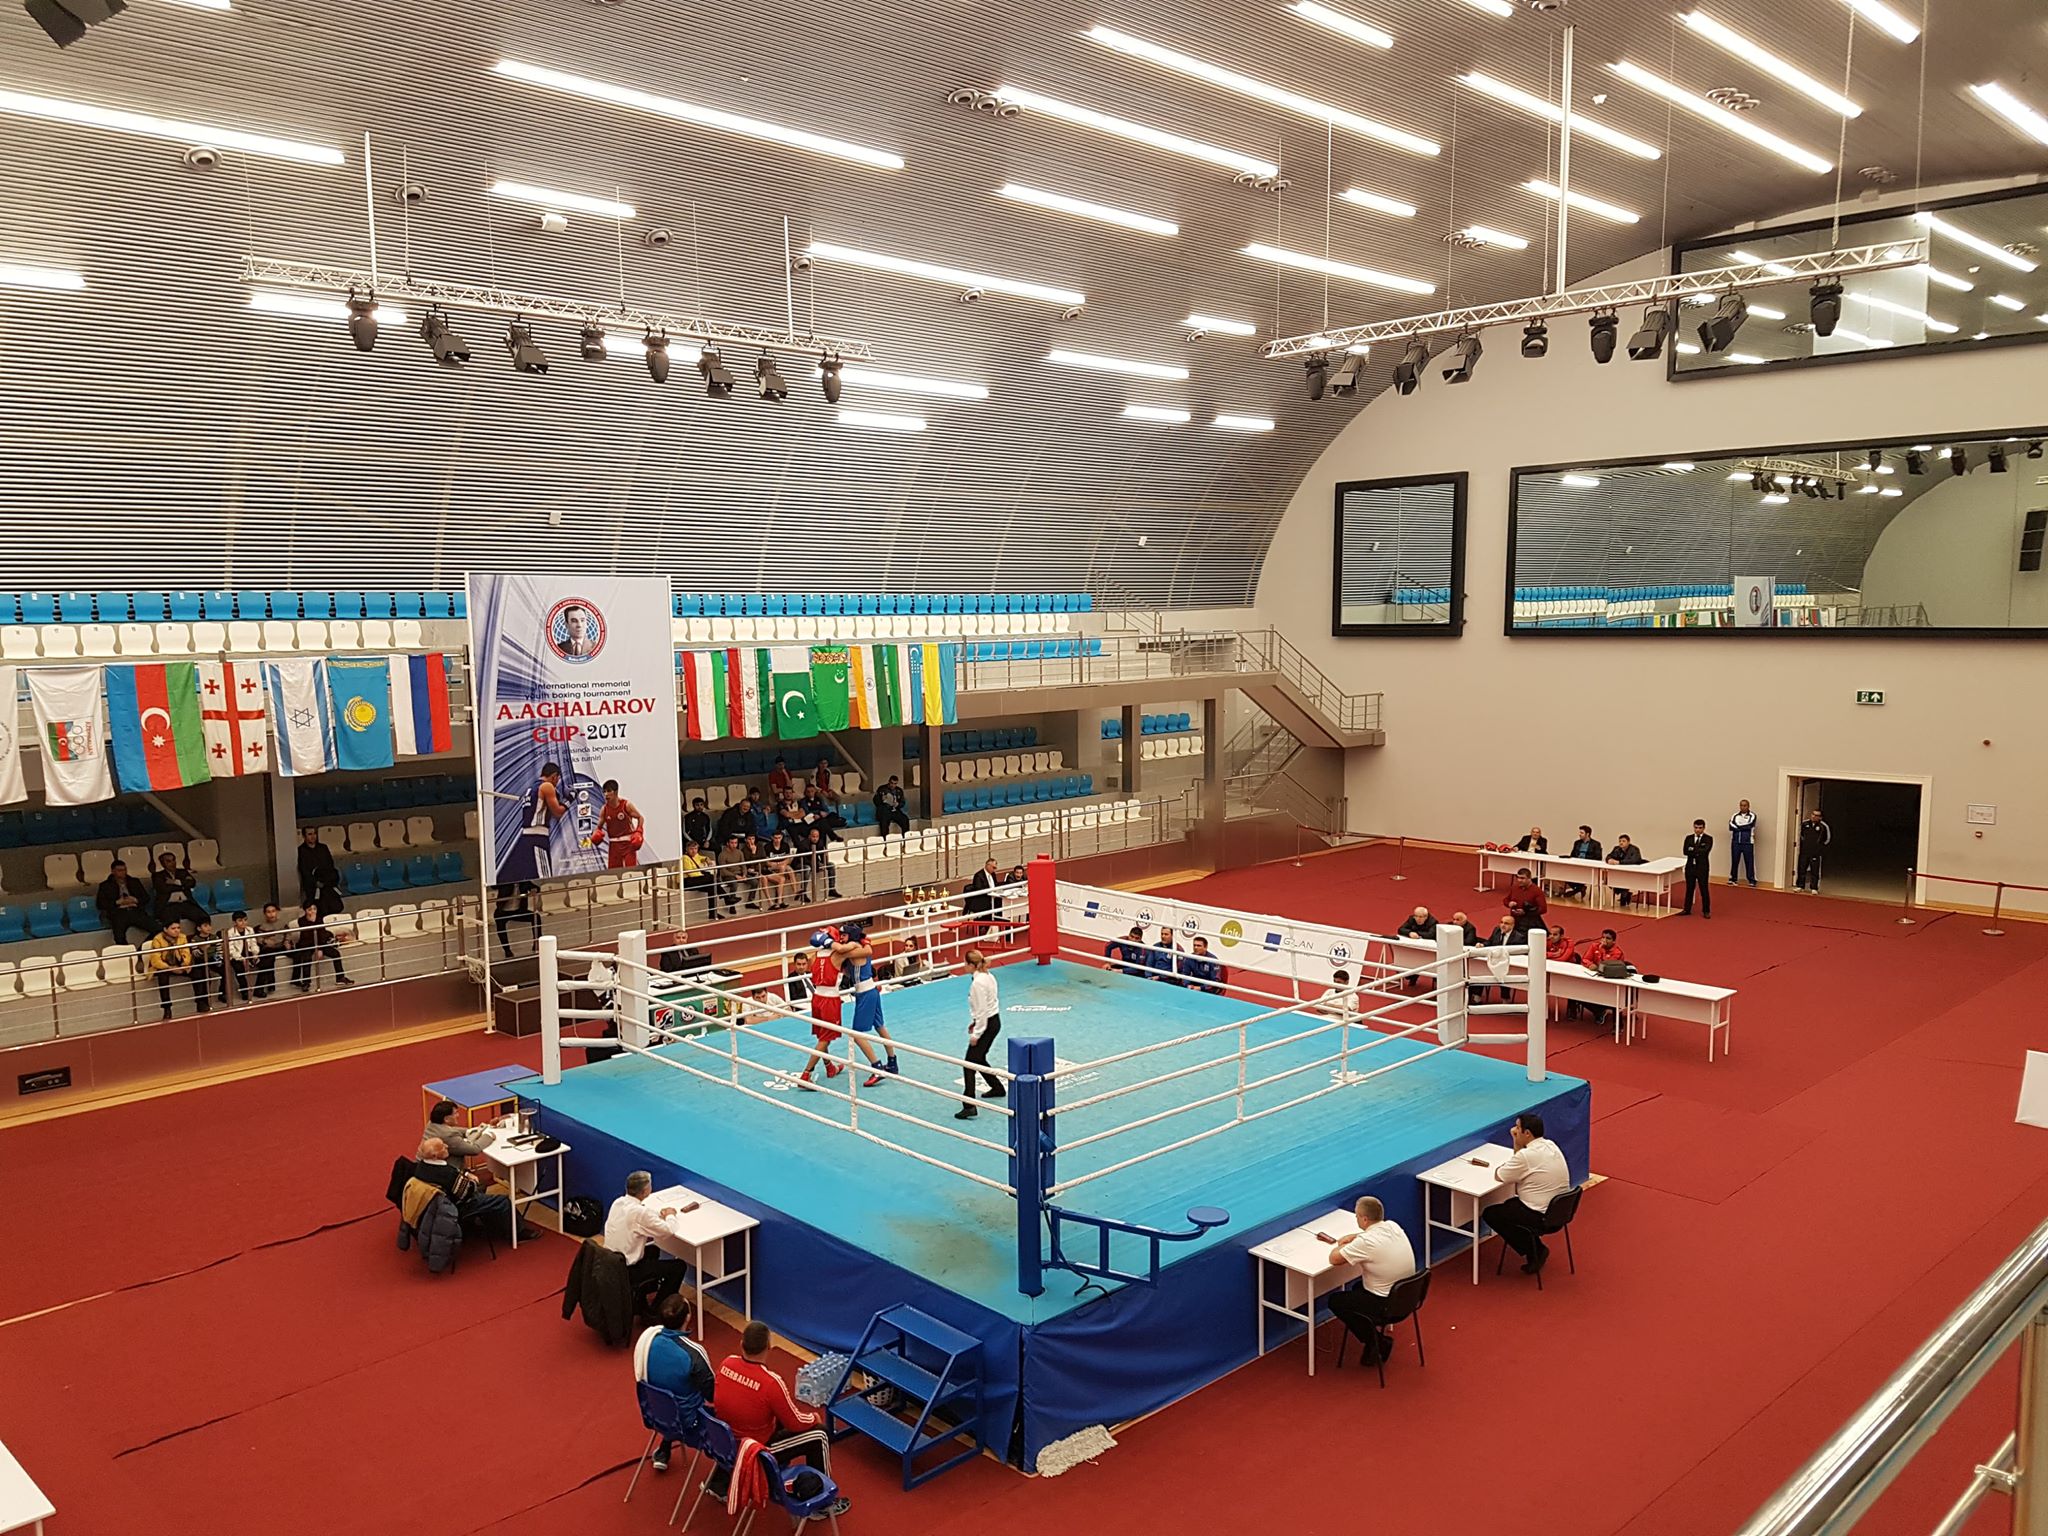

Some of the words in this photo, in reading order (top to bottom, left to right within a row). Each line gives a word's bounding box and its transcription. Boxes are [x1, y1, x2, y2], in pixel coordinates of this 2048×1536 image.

[591, 680, 631, 689] memorial
[552, 690, 581, 700] boxing
[583, 689, 631, 698] tournament
[497, 698, 656, 720] A.AGHALAROV
[532, 723, 627, 743] CUP-2017
